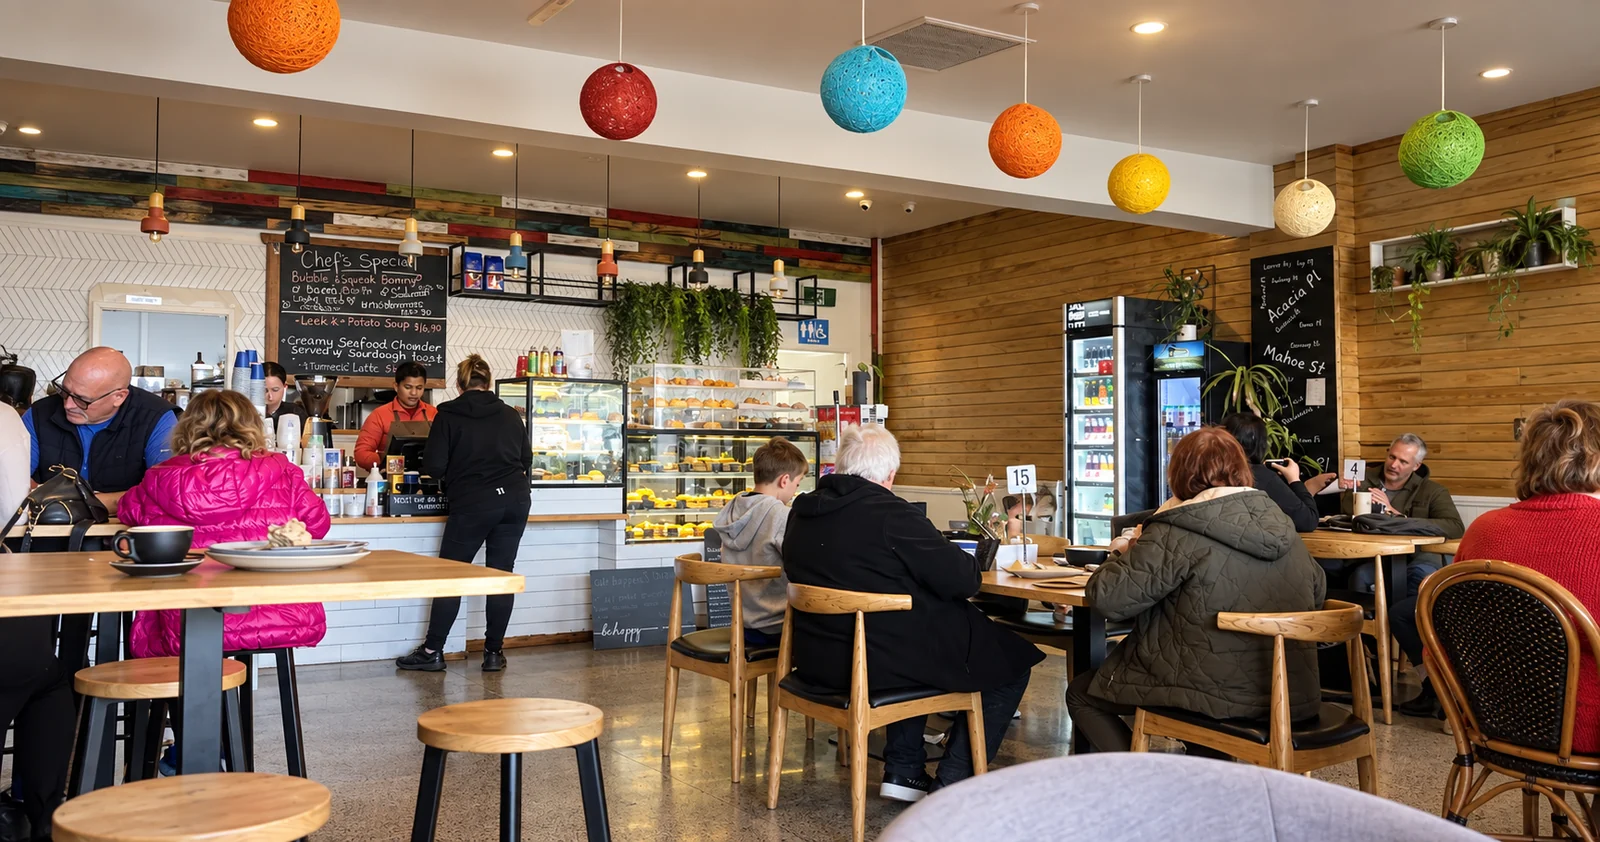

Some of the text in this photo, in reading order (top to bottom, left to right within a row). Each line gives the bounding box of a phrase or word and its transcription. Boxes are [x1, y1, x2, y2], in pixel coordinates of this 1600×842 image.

[301, 250, 417, 275] Chef's Special
[292, 270, 329, 284] Bubble
[341, 274, 376, 287] Squeak
[1267, 288, 1307, 323] Acacia
[1306, 269, 1322, 289] Pl
[301, 315, 328, 326] Leek
[384, 318, 410, 332] Soup
[287, 335, 334, 349] Creamy
[337, 336, 388, 350] Seafood
[291, 345, 329, 355] Served
[1263, 344, 1305, 370] Mahoe
[1309, 360, 1326, 375] St
[1013, 468, 1030, 486] 15
[1350, 462, 1358, 475] 4
